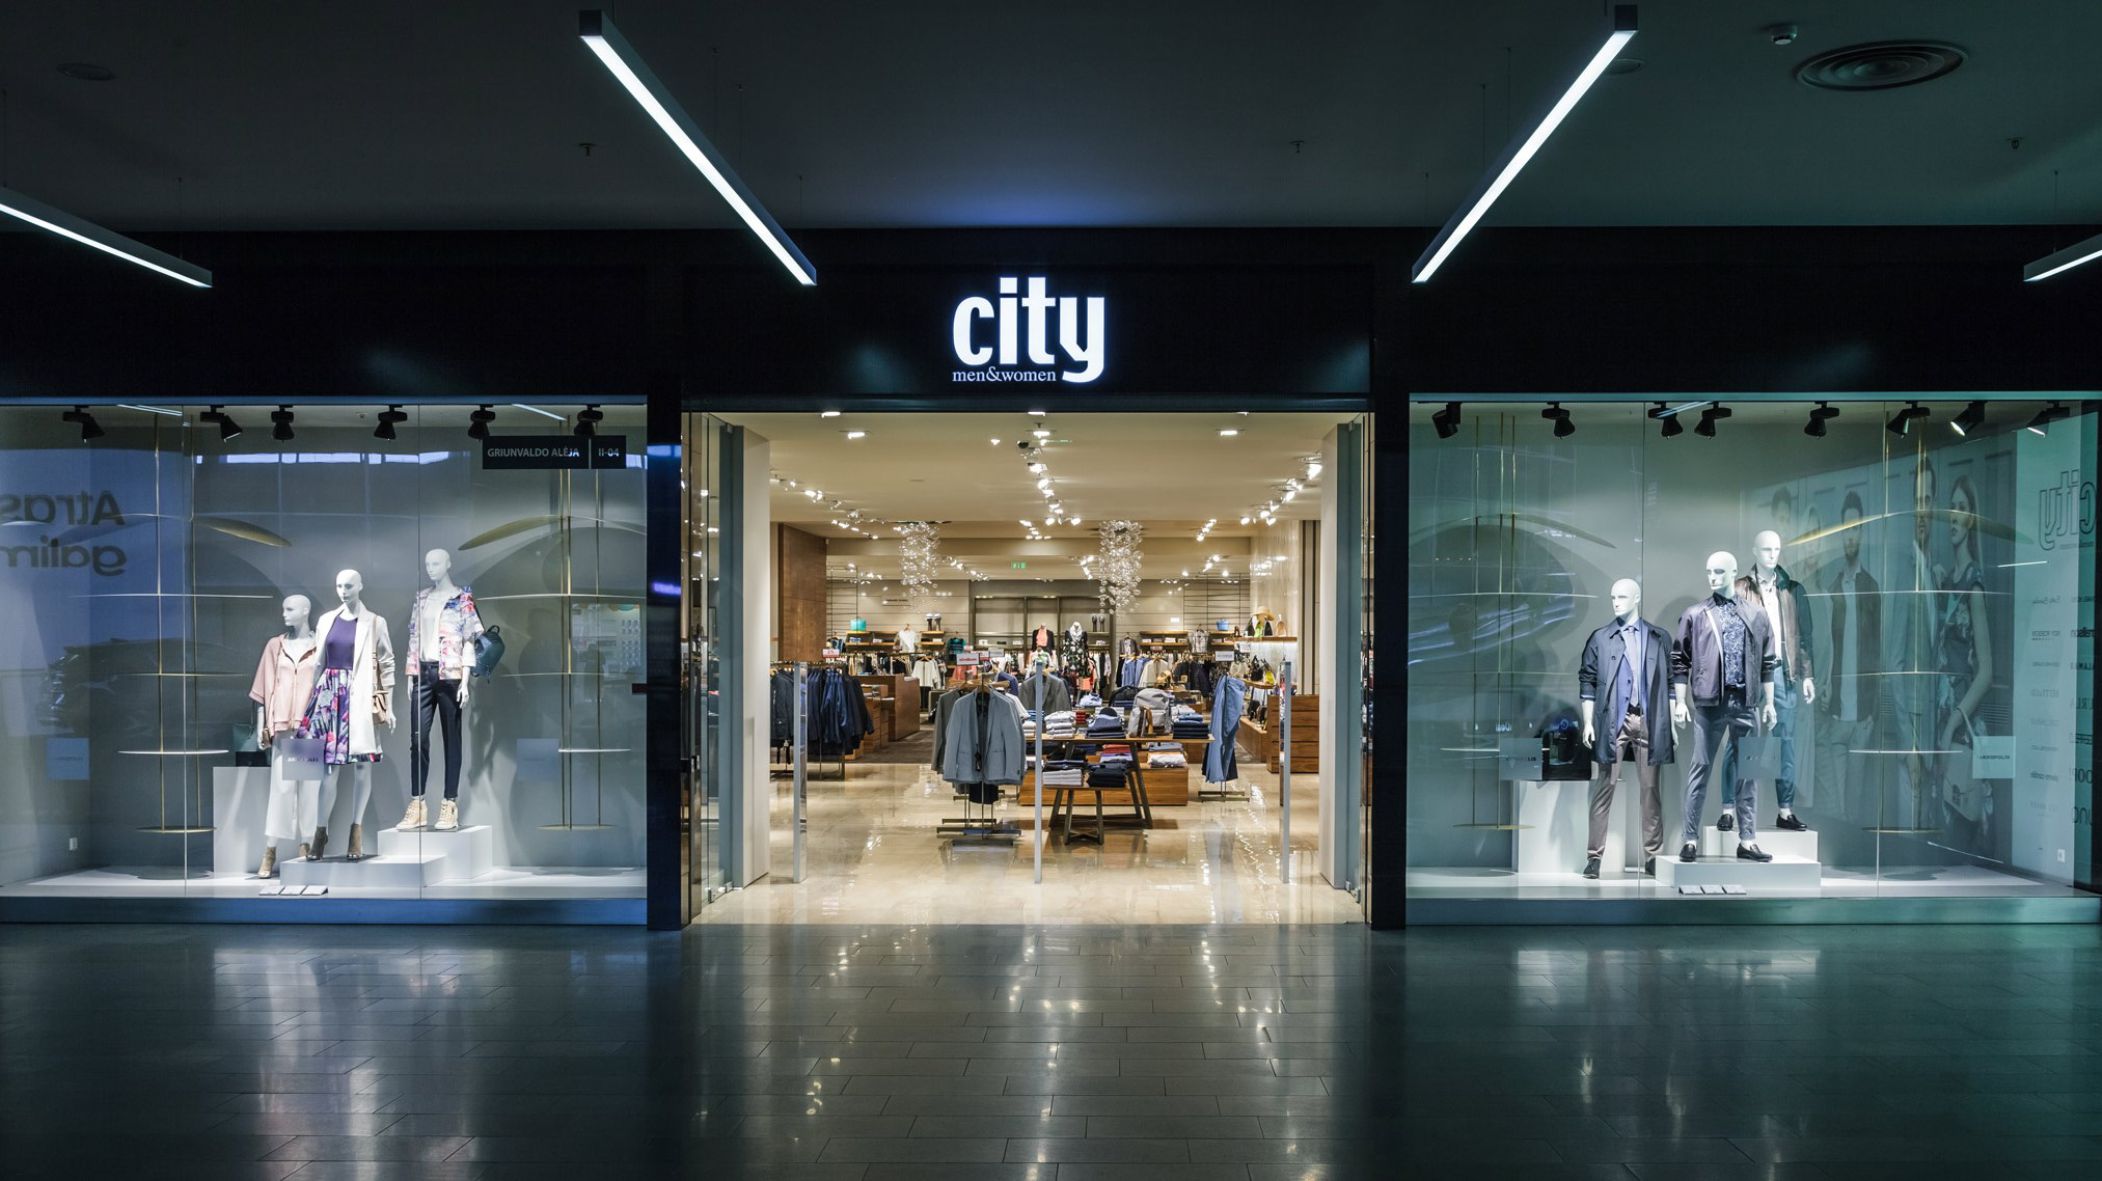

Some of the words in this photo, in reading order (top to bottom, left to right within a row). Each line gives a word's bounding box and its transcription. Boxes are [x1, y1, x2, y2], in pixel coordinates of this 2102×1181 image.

[953, 277, 1105, 383] city
[952, 366, 1057, 382] men&women
[488, 447, 549, 457] GRIUNVALDO
